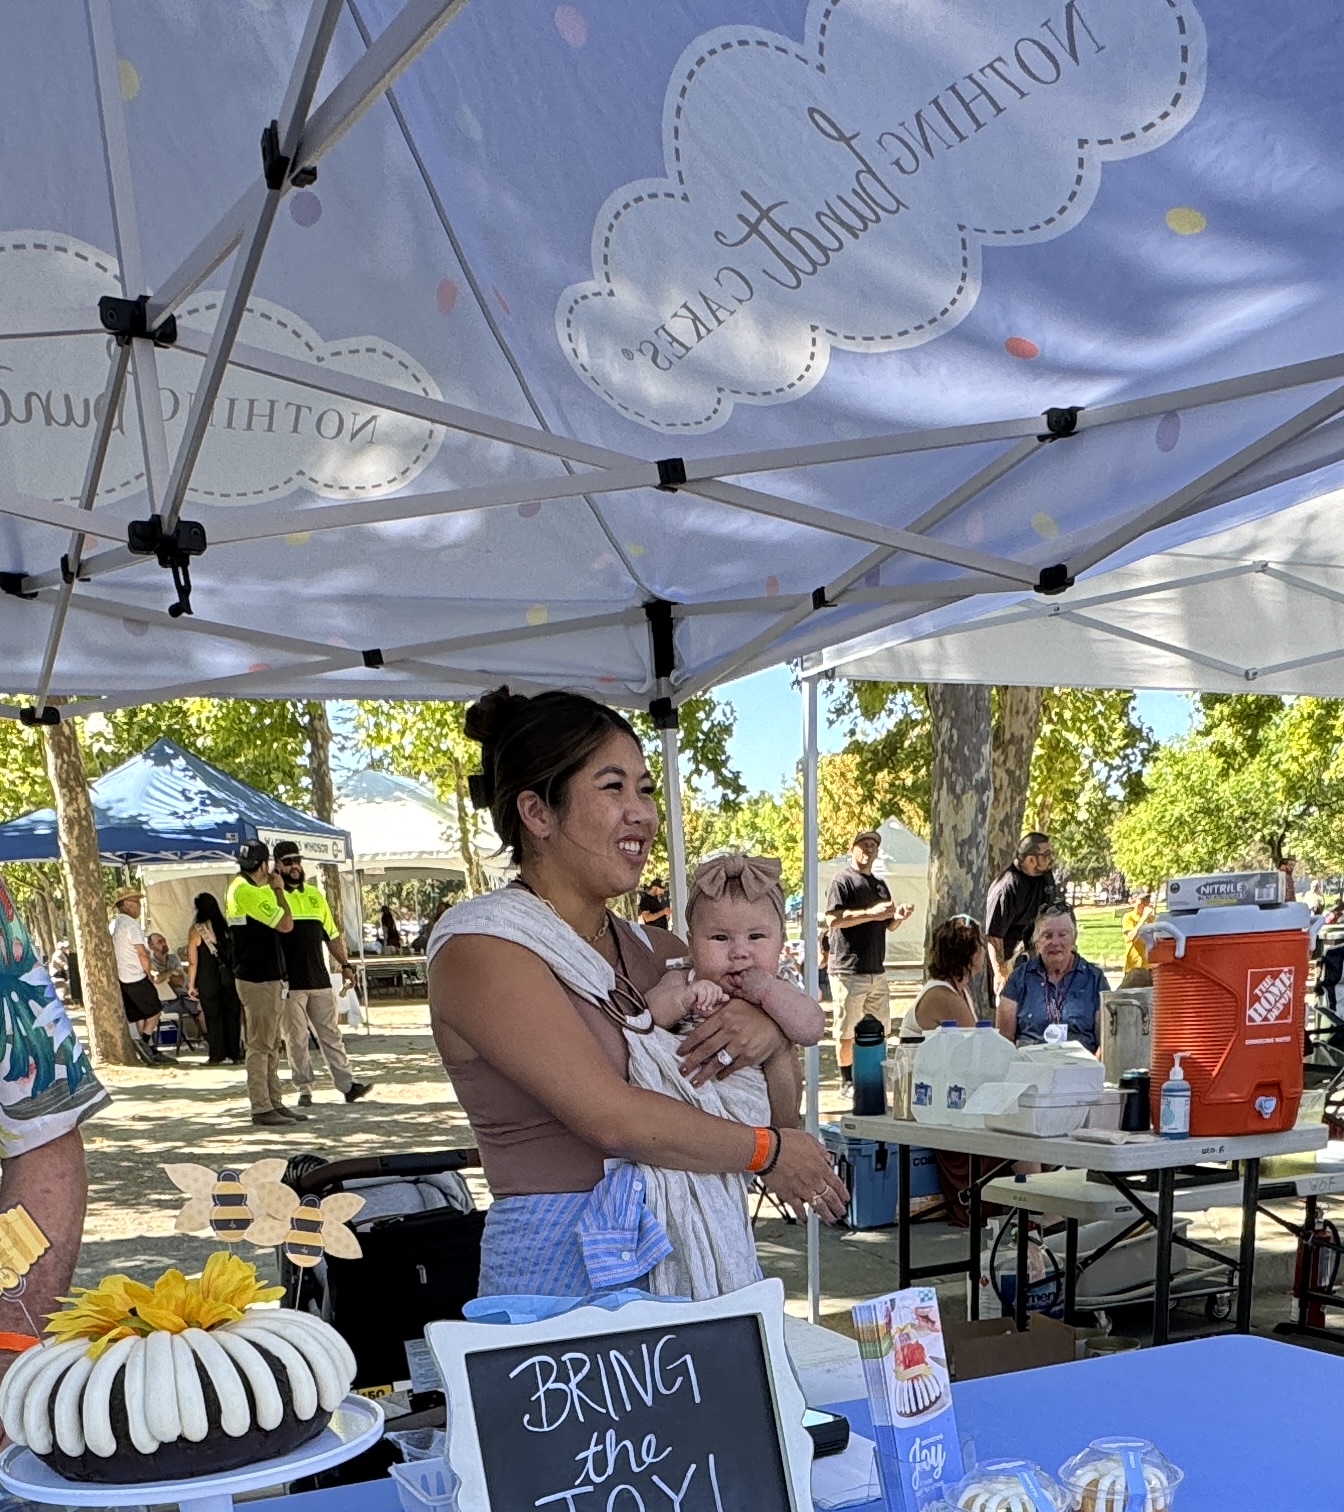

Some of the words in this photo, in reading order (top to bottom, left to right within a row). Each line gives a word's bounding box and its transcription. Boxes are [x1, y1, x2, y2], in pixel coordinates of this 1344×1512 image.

[1200, 883, 1243, 895] NITRILE
[1248, 968, 1293, 1023] HOME
[1253, 974, 1274, 997] THE
[1266, 987, 1292, 1022] DEPOT
[509, 1333, 702, 1433] BRING
[573, 1429, 674, 1488] the
[909, 1437, 947, 1491] Joy
